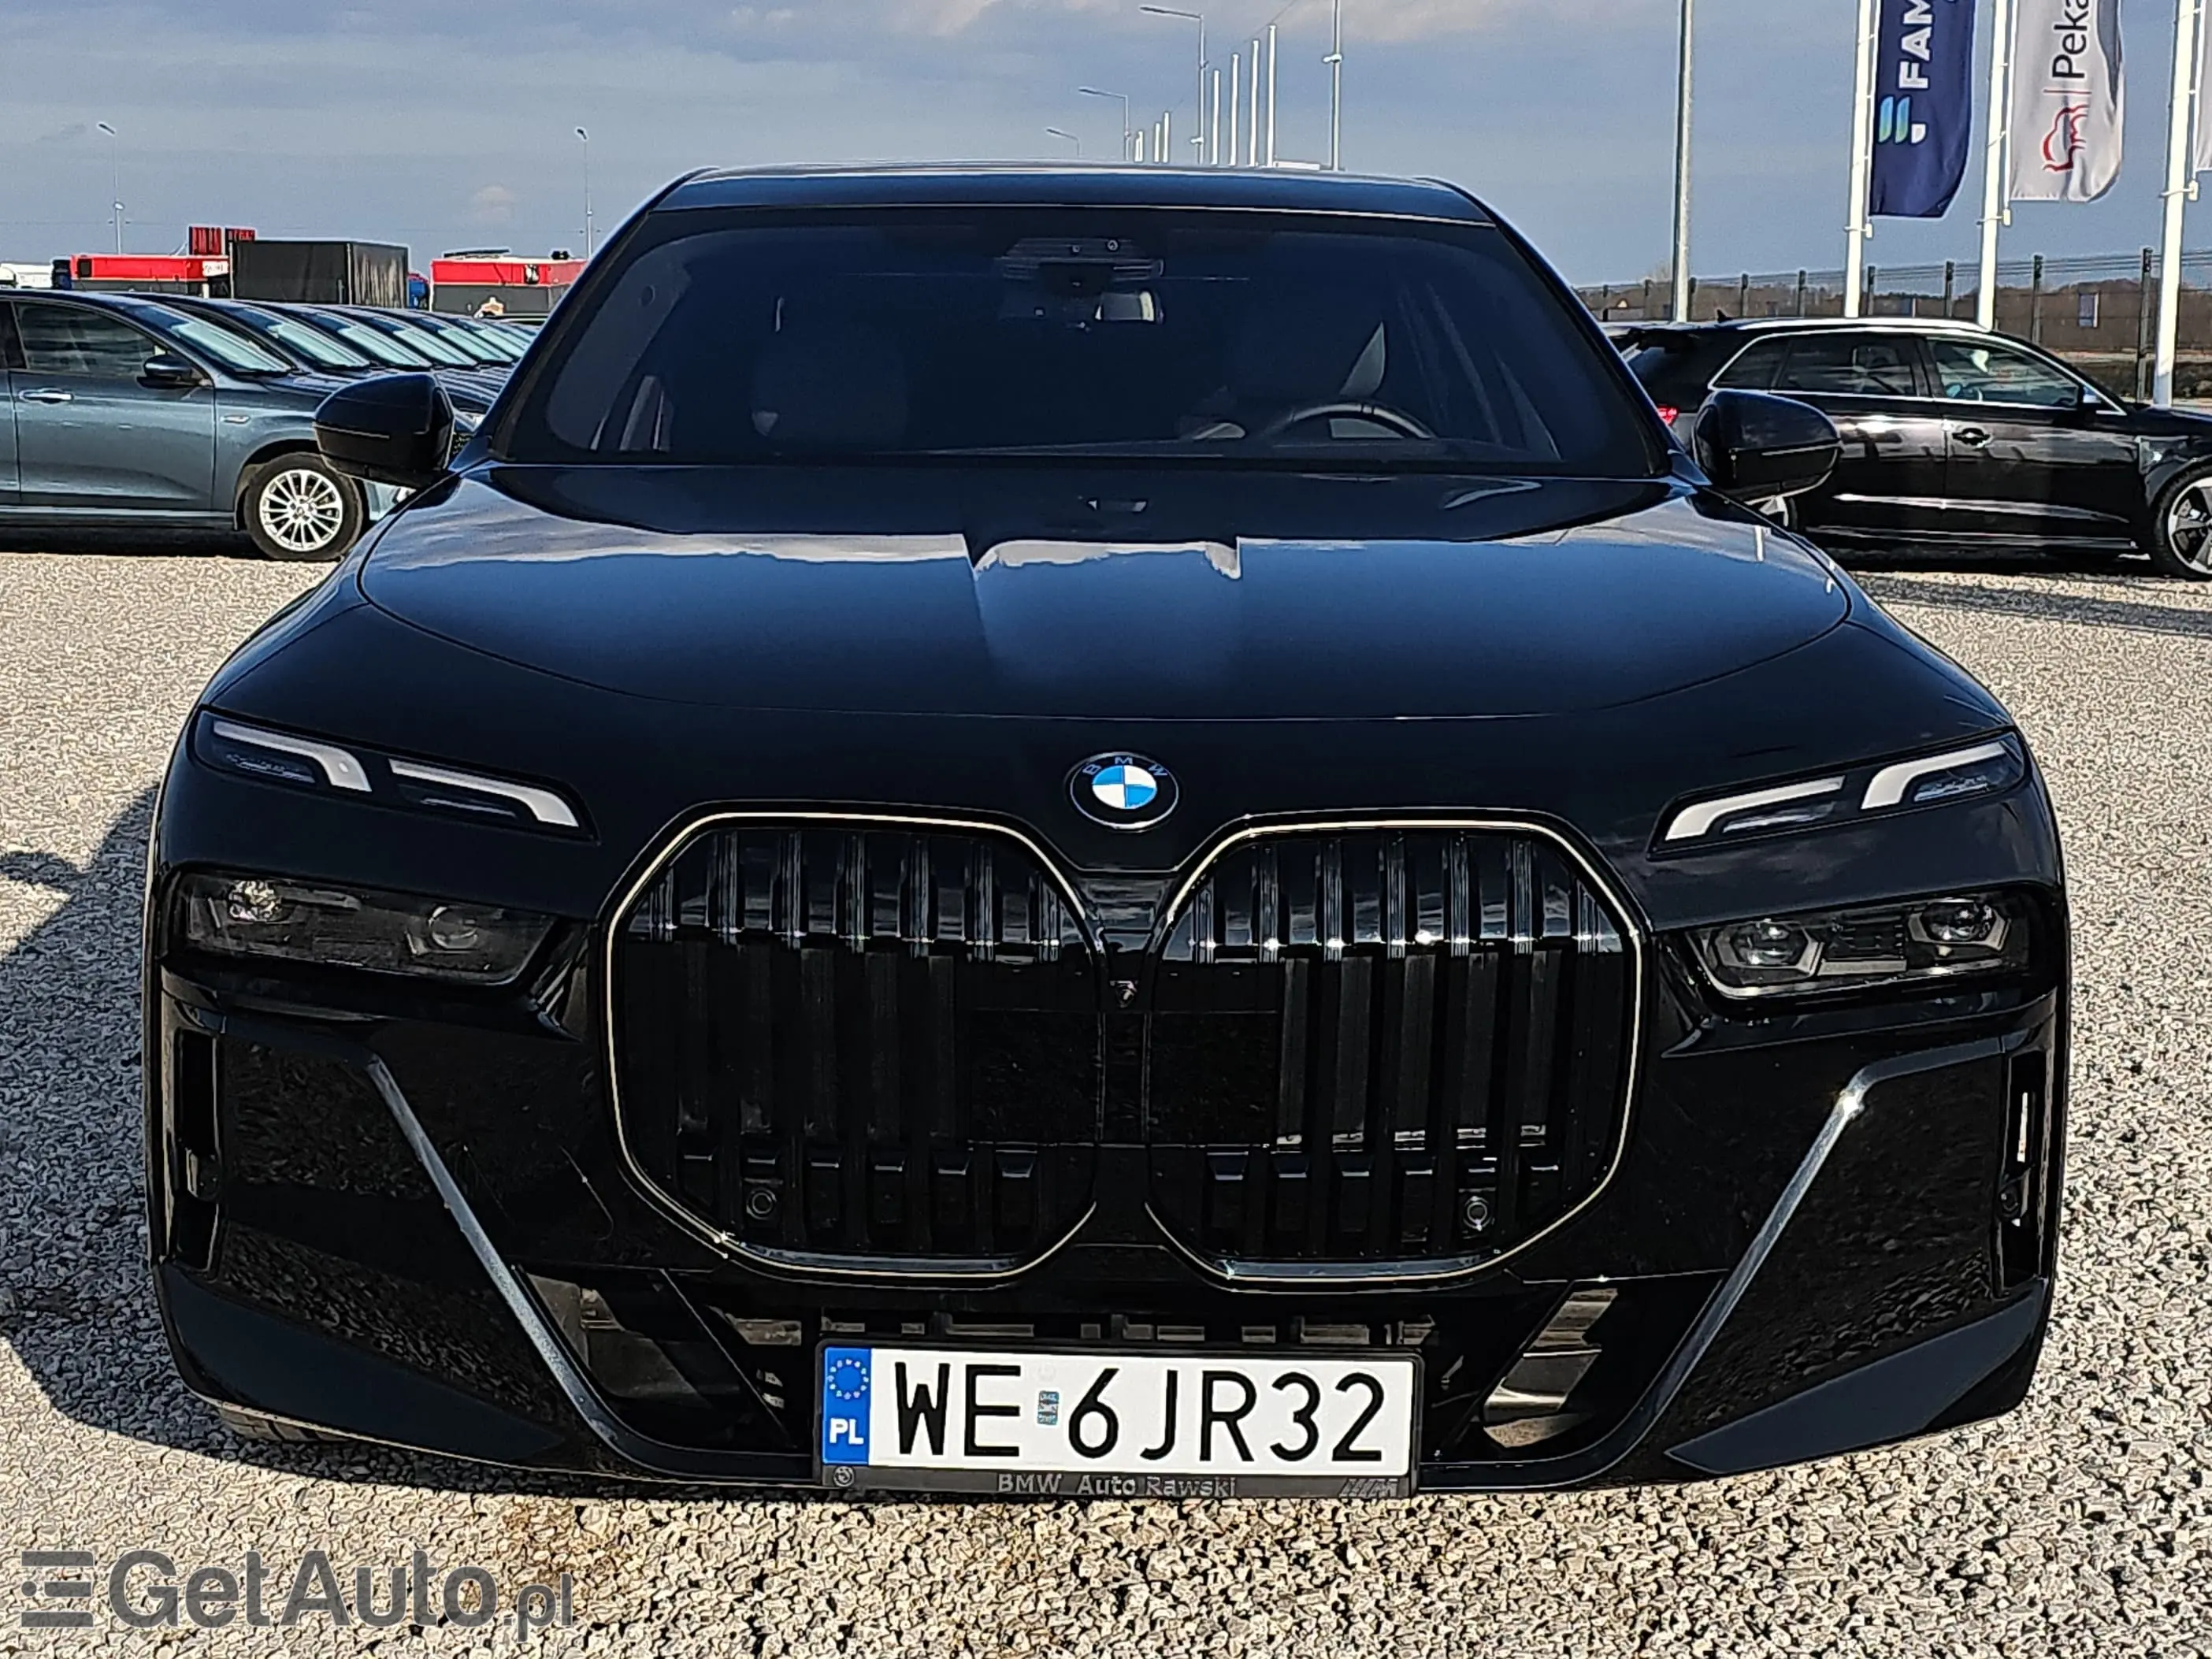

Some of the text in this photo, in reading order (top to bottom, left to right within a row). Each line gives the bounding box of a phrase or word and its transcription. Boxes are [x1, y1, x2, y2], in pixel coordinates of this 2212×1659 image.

[1082, 756, 1167, 776] BMW
[894, 1362, 1382, 1462] WE 6JR32
[830, 1418, 864, 1445] PL
[997, 1473, 1236, 1497] BMW Auto Rawski
